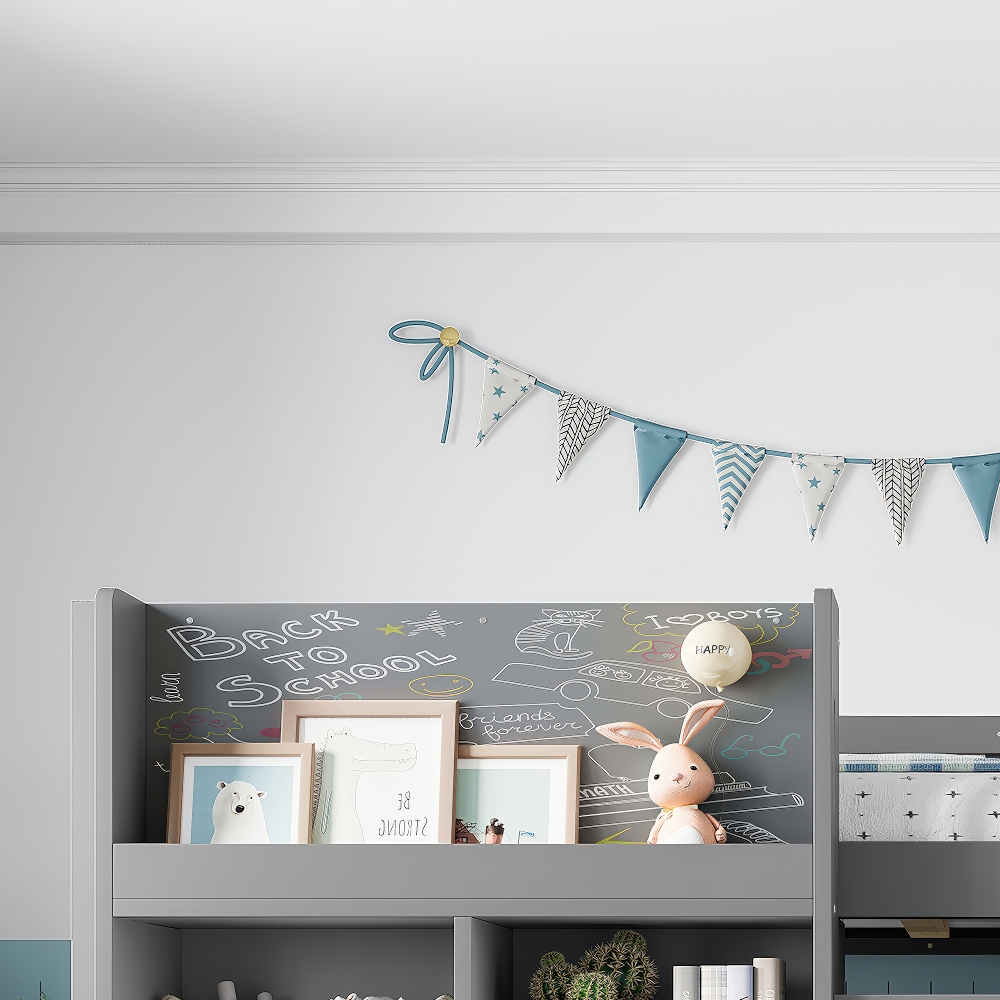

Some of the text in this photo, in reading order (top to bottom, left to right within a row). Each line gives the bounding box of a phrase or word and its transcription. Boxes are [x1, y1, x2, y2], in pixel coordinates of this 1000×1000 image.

[706, 607, 783, 622] BOYS
[166, 610, 360, 661] BACK
[263, 646, 348, 672] TO
[695, 644, 732, 655] HAPPY
[215, 650, 457, 708] SCHOOL
[458, 710, 556, 731] friends
[481, 720, 583, 741] forever
